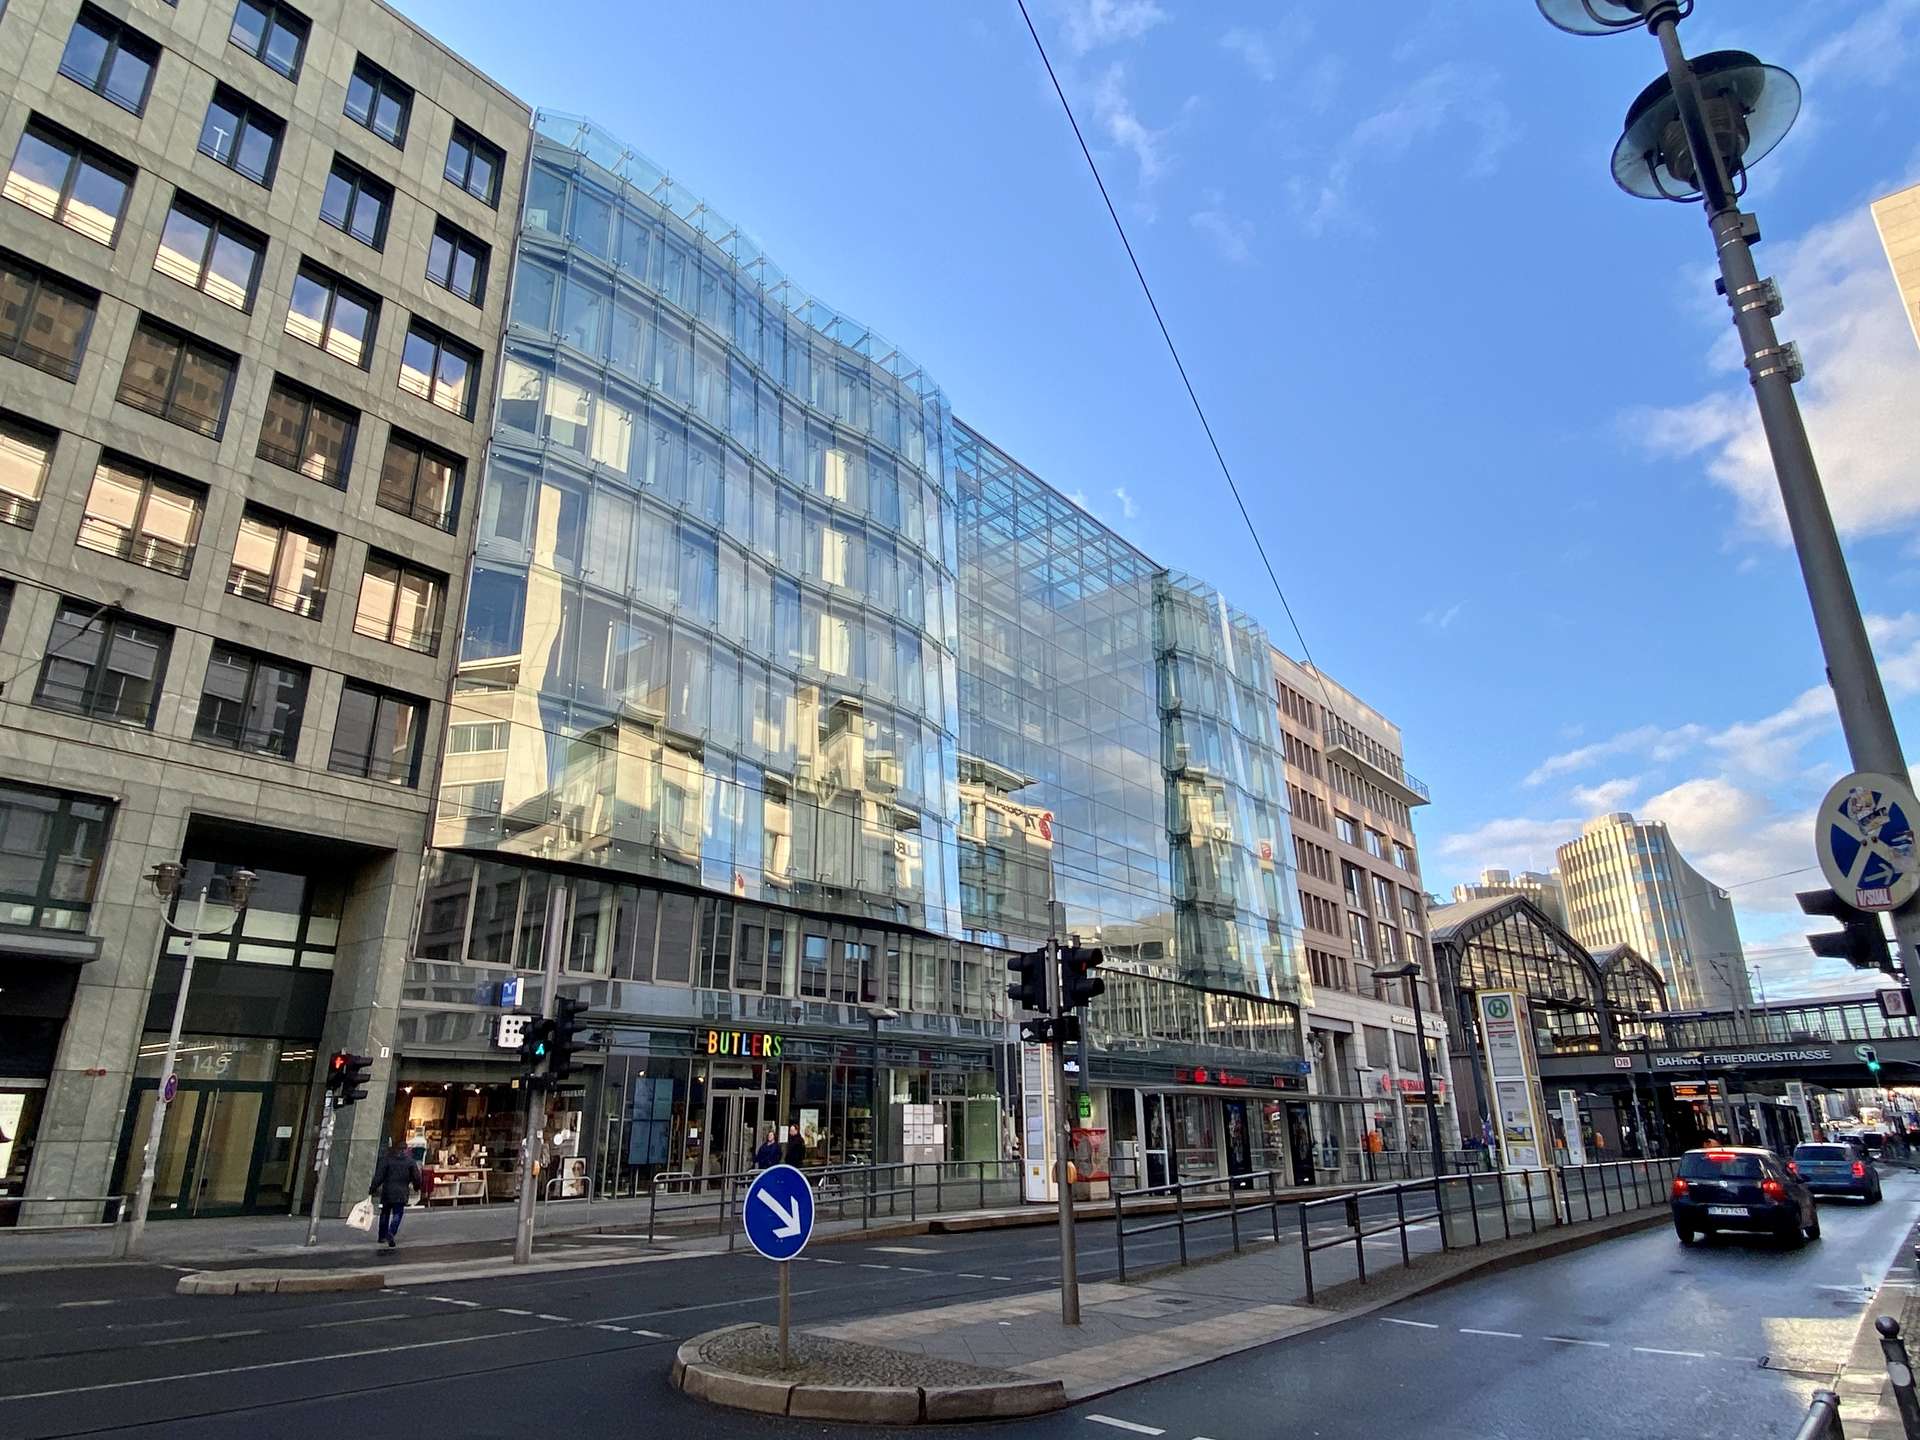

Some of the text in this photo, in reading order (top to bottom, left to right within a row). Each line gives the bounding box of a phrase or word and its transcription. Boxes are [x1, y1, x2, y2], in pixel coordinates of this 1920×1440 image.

[707, 1030, 783, 1057] BUTLERS
[192, 1055, 229, 1074] 149
[1616, 1058, 1630, 1067] DB
[1713, 1050, 1832, 1064] FRIEDRICHSTRASSE
